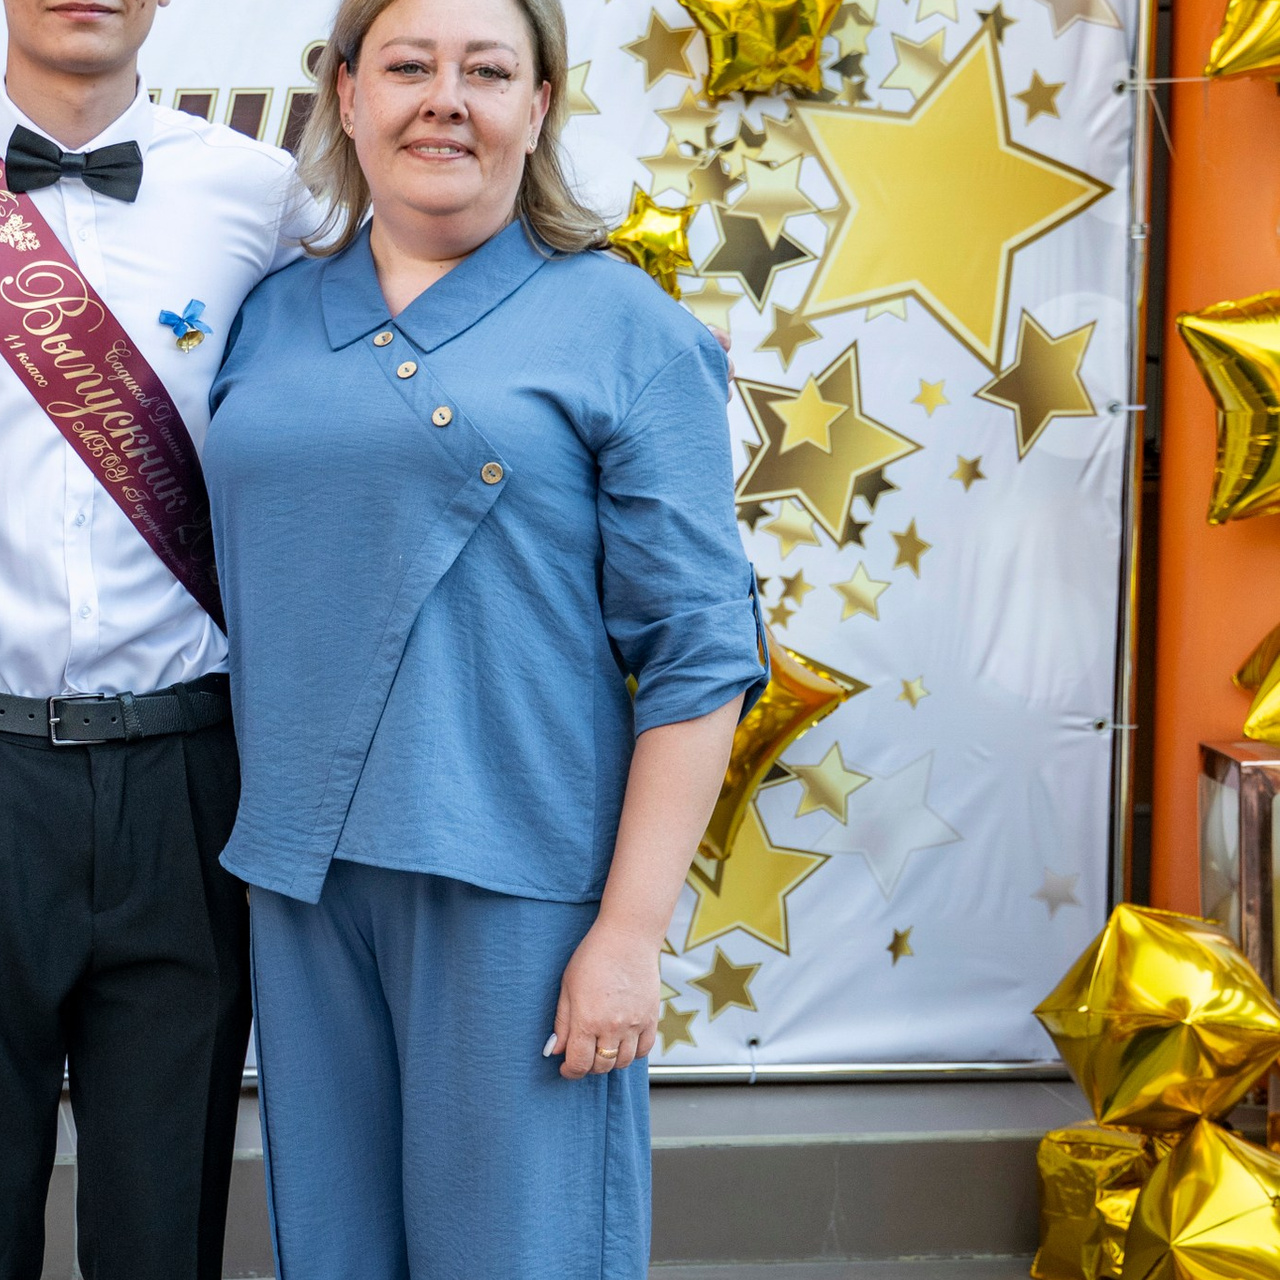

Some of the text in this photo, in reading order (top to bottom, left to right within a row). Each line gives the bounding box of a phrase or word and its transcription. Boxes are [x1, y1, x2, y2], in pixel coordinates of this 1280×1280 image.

[0, 260, 188, 515] Выпускник
[4, 333, 49, 388] 11 класс
[104, 339, 152, 408] Садиков
[72, 420, 134, 482] МБОУ
